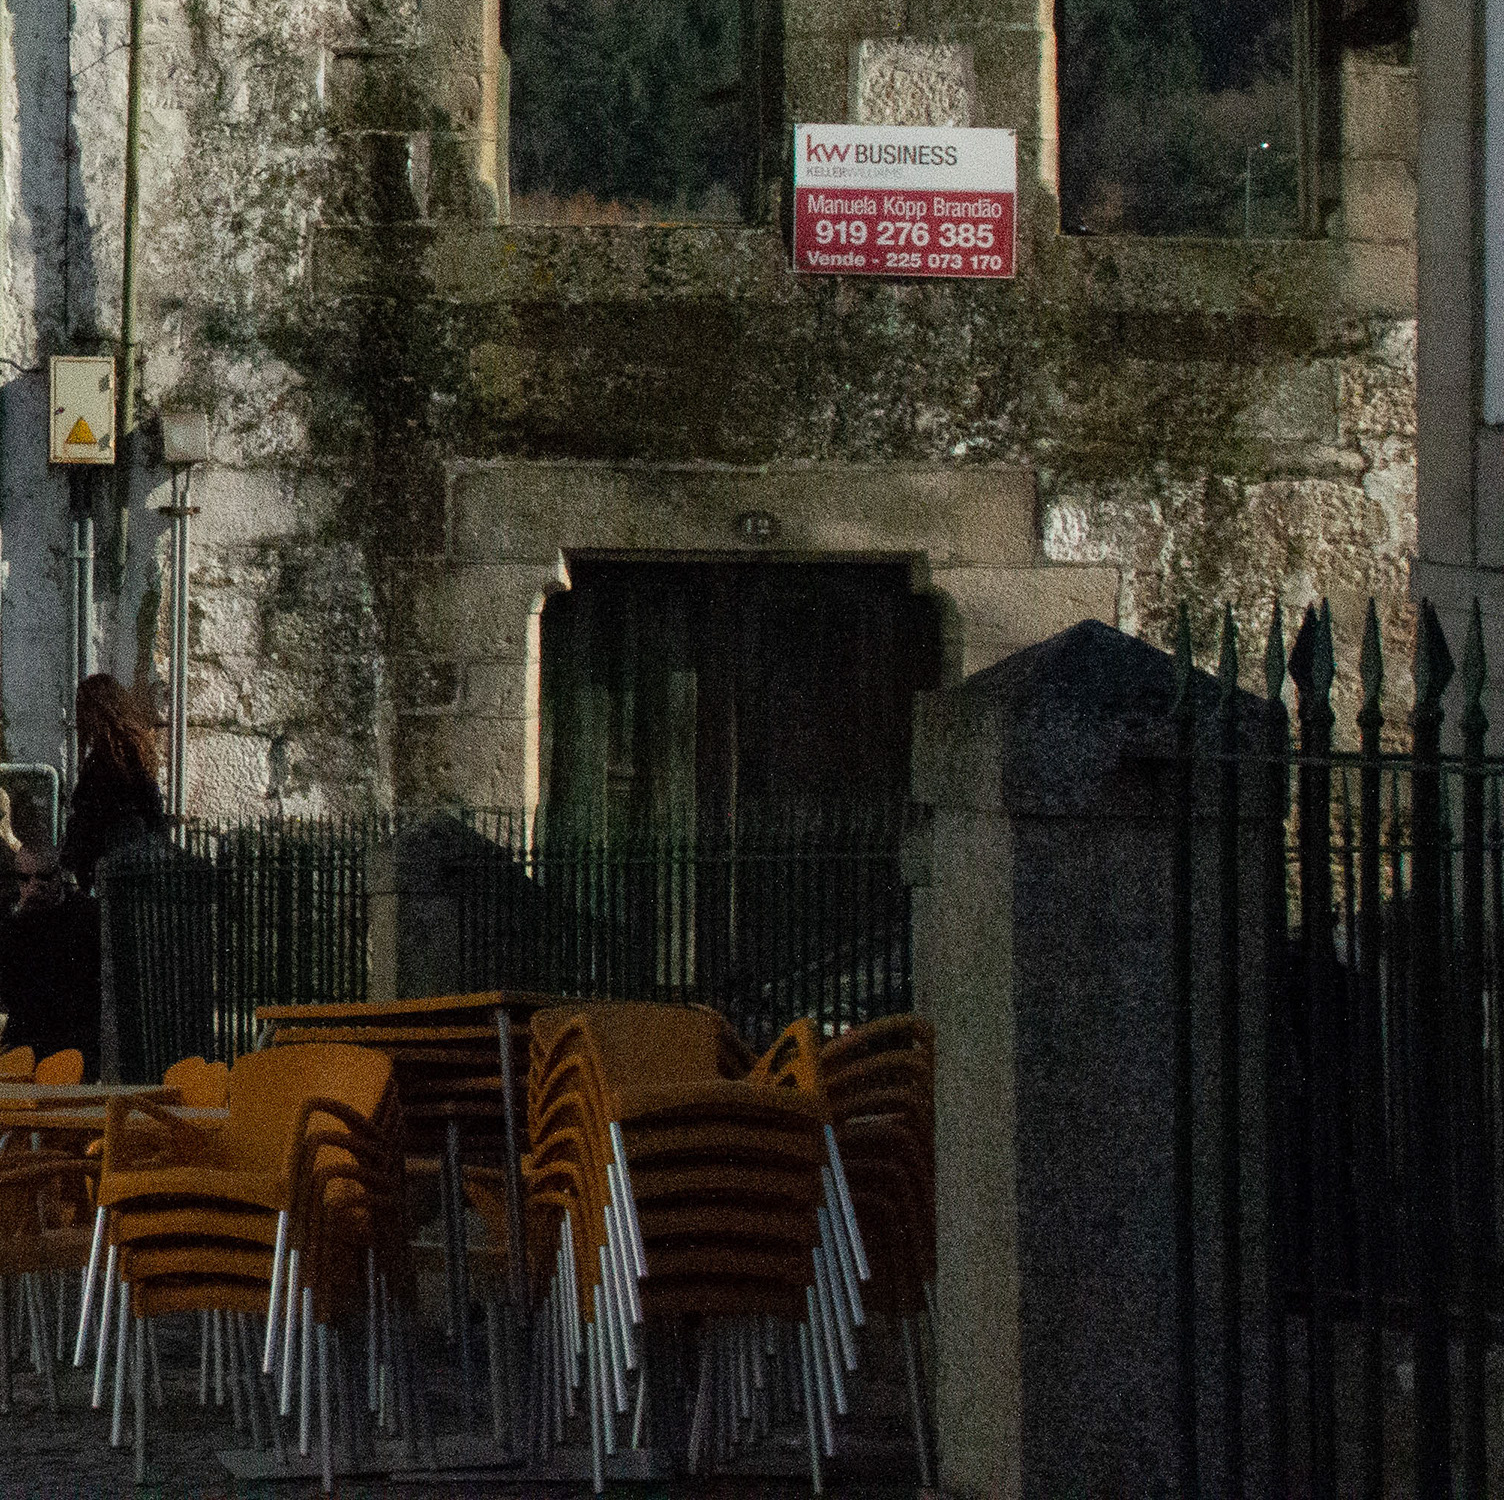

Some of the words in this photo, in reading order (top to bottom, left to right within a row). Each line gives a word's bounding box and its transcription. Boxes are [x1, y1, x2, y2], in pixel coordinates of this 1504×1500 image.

[806, 134, 850, 162] kw
[855, 144, 957, 166] BUSINESS
[808, 195, 877, 215] Manuela
[884, 196, 927, 220] Köpp
[933, 198, 1002, 219] Brandão
[815, 219, 867, 245] 919
[876, 221, 930, 247] 276
[939, 223, 994, 248] 385
[807, 250, 865, 267] Vende
[886, 253, 922, 269] 225
[928, 254, 963, 270] 073
[970, 254, 1002, 271] 170
